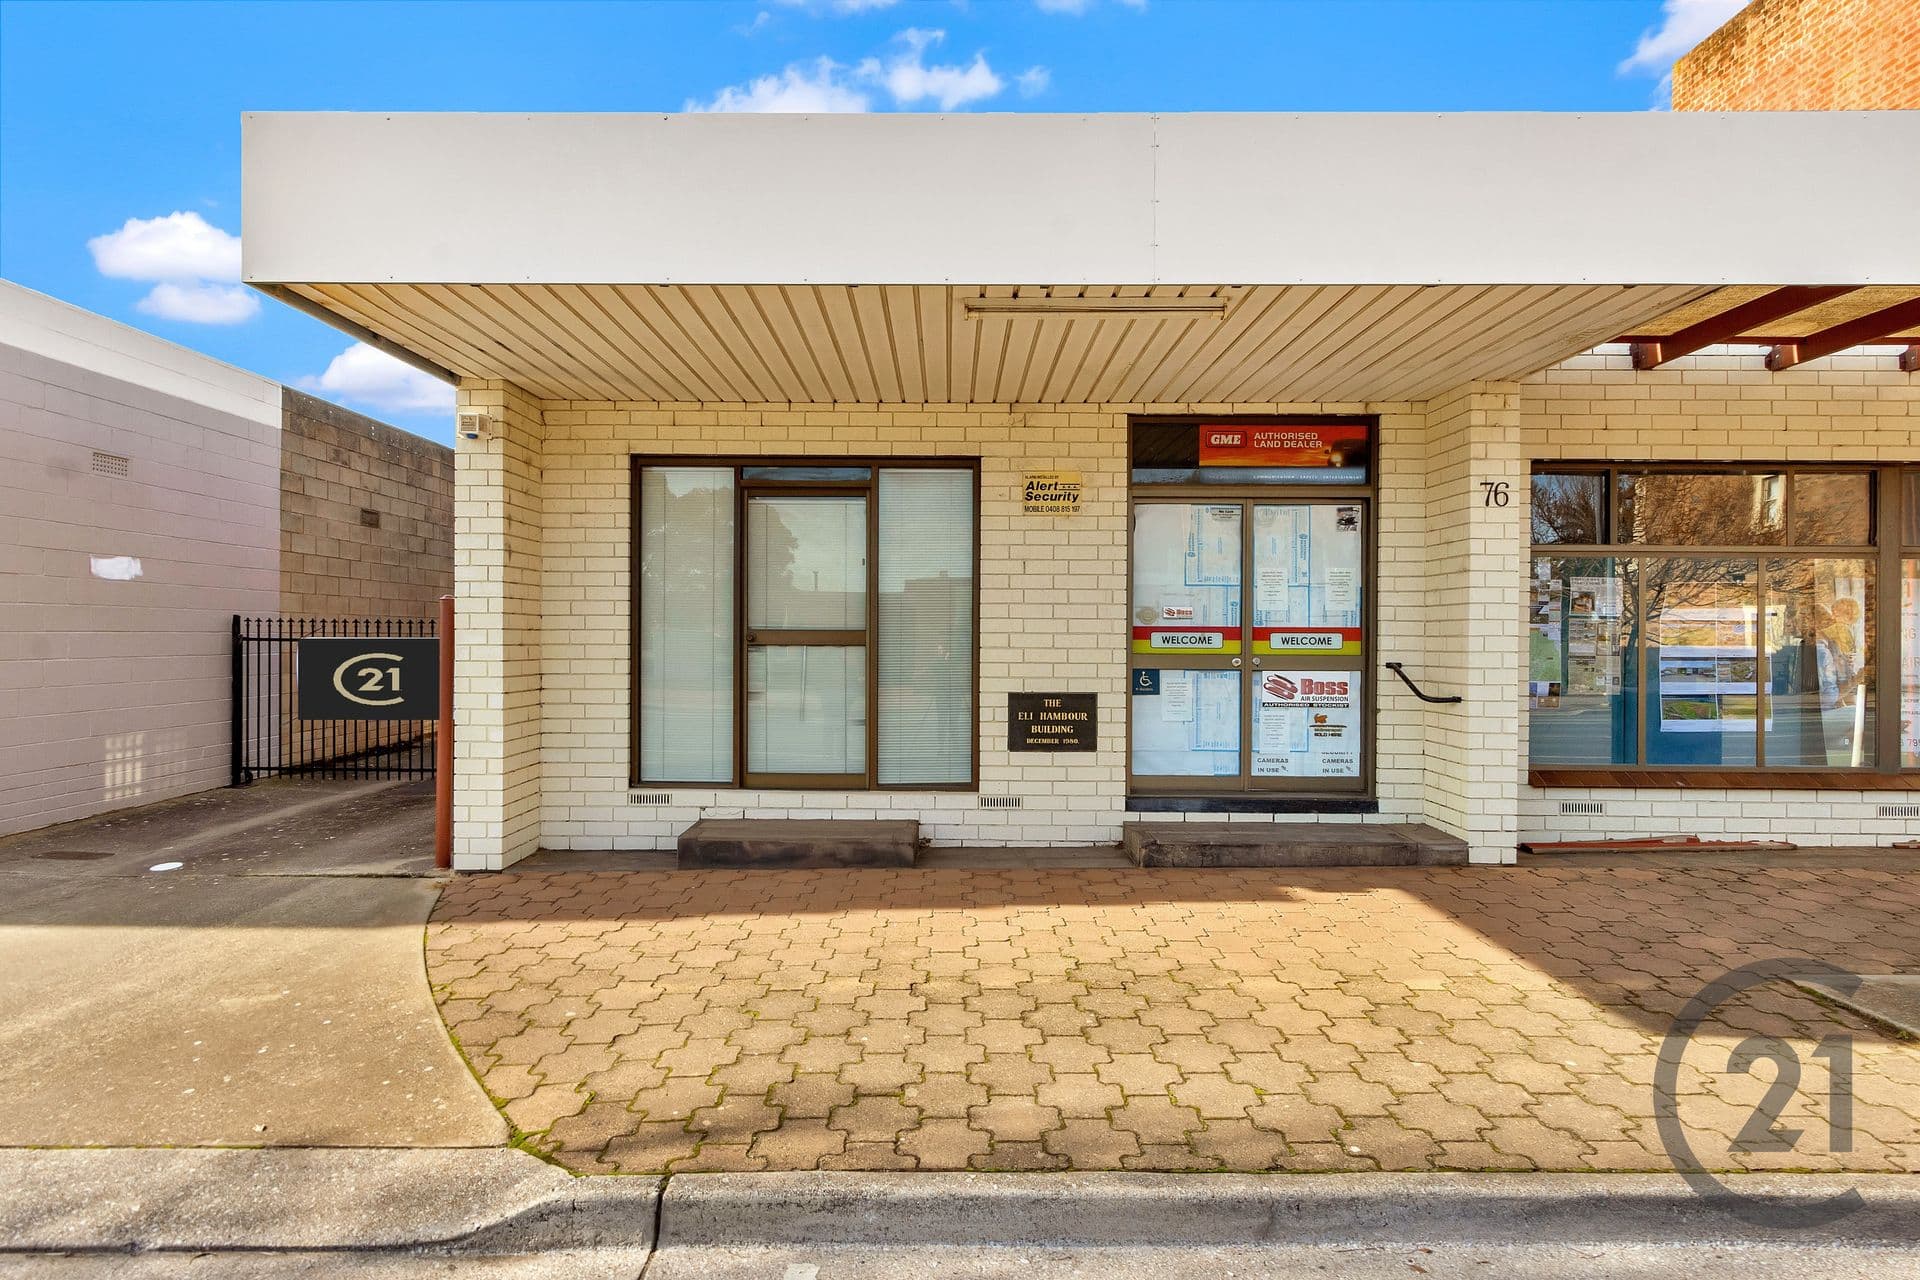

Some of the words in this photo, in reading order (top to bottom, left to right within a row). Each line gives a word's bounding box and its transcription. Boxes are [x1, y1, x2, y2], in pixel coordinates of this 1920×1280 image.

[1210, 434, 1241, 445] GME
[1254, 432, 1318, 440] AUTHORISED
[1254, 440, 1281, 448] LAND
[1284, 440, 1323, 448] DEALER
[1025, 481, 1058, 491] Alert
[1024, 491, 1079, 503] Security
[1480, 481, 1510, 507] 76
[1024, 505, 1045, 513] MOBILE
[1161, 635, 1213, 645] WELCOME
[1281, 636, 1333, 646] WELCOME
[1043, 698, 1063, 708] THE
[1018, 711, 1034, 721] ELI
[1040, 711, 1089, 721] HAMBOUR
[1031, 725, 1074, 734] BUILDING
